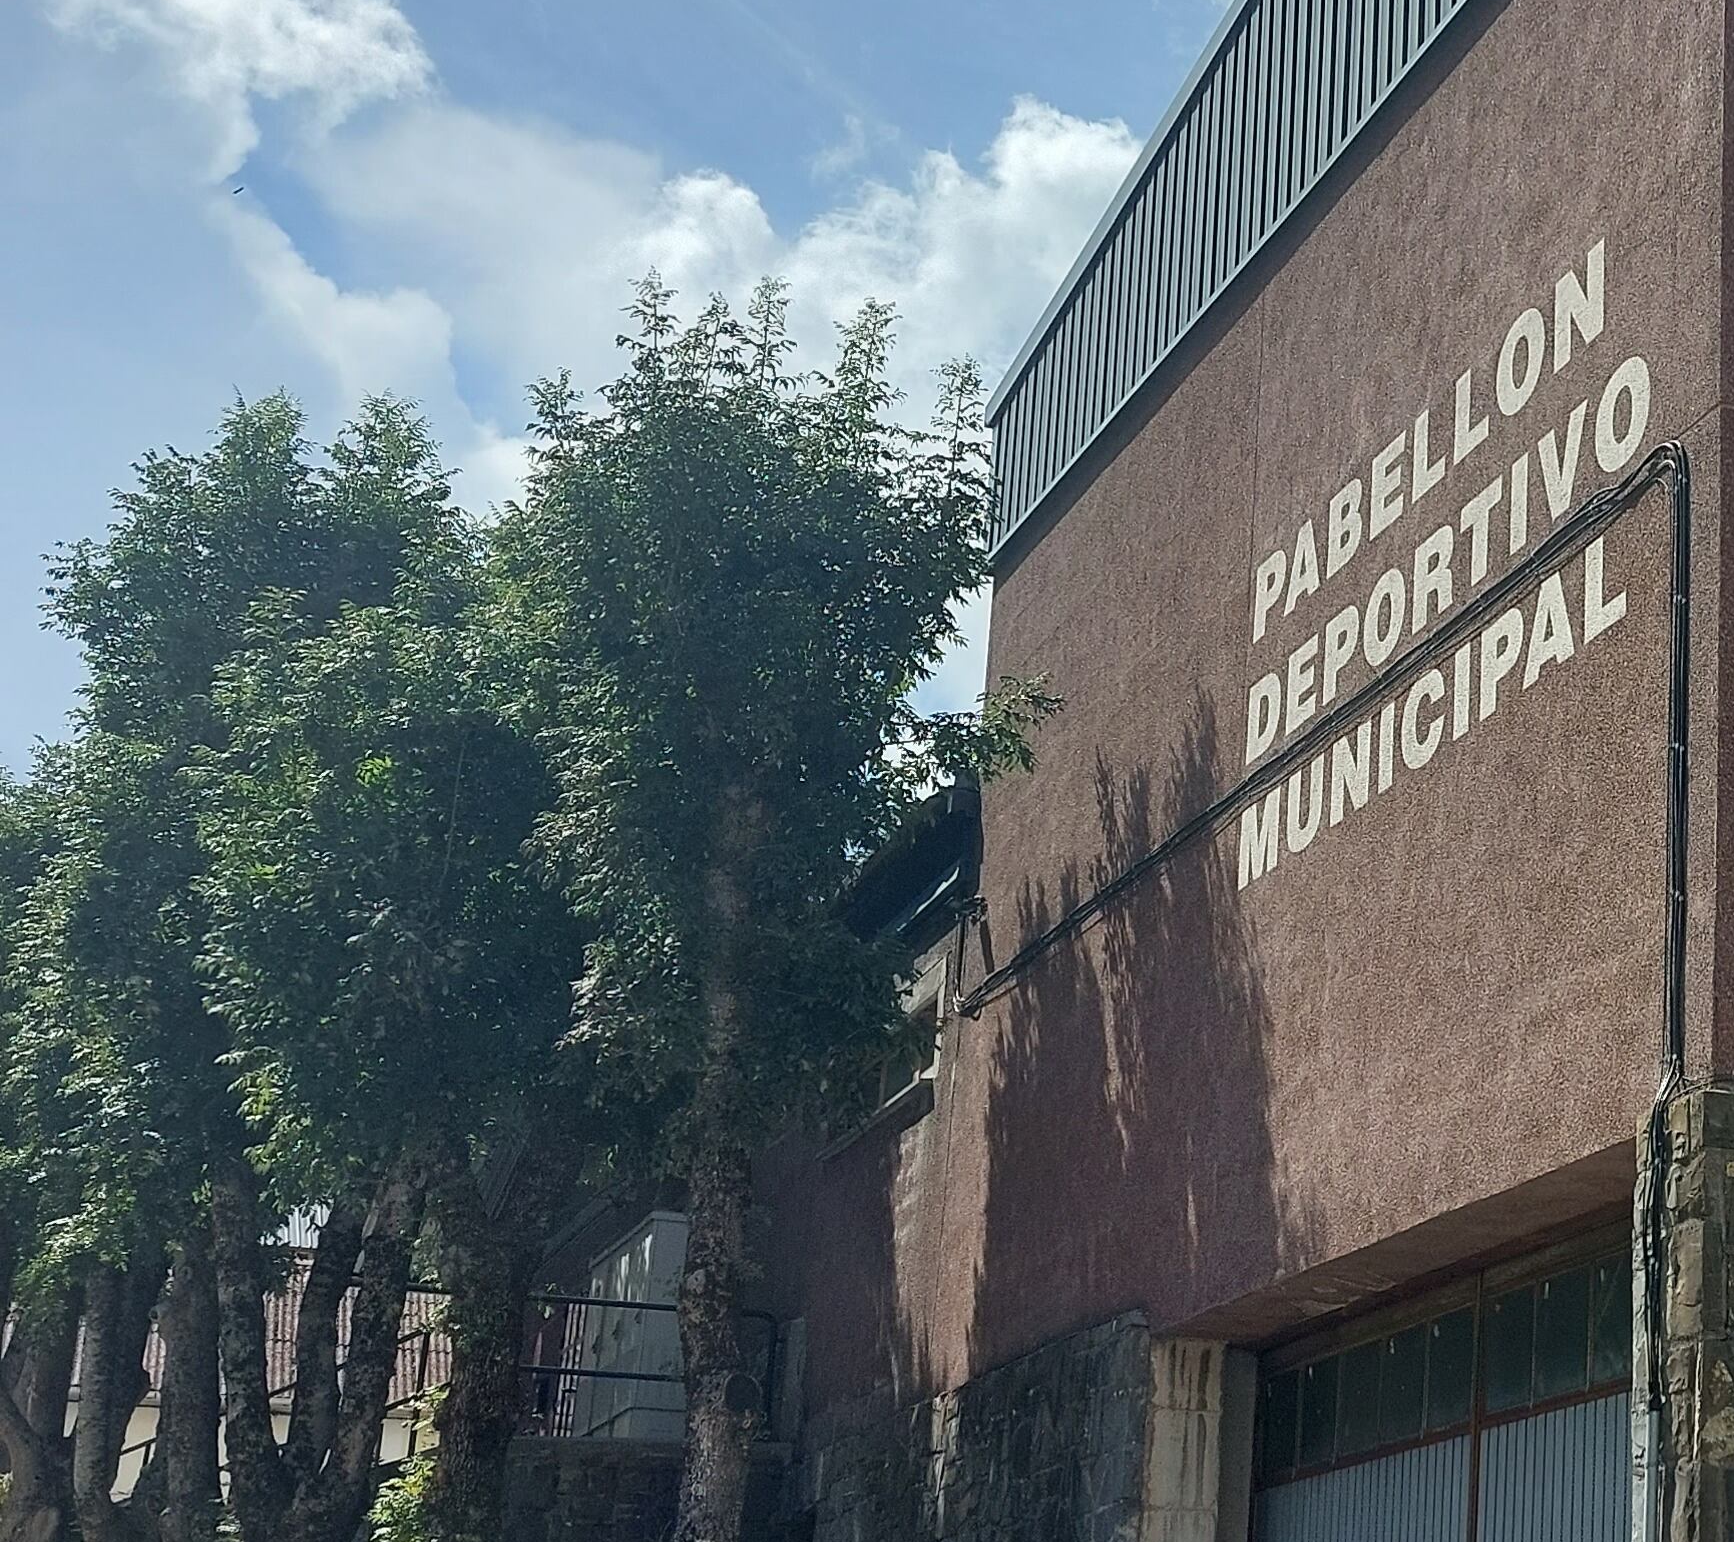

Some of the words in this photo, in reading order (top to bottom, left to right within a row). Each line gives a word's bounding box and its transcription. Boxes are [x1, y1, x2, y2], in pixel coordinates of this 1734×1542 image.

[1245, 356, 1651, 766] DEPORTIVO
[1253, 238, 1605, 644] PABELLON
[1237, 536, 1628, 892] MUNICIPAL
